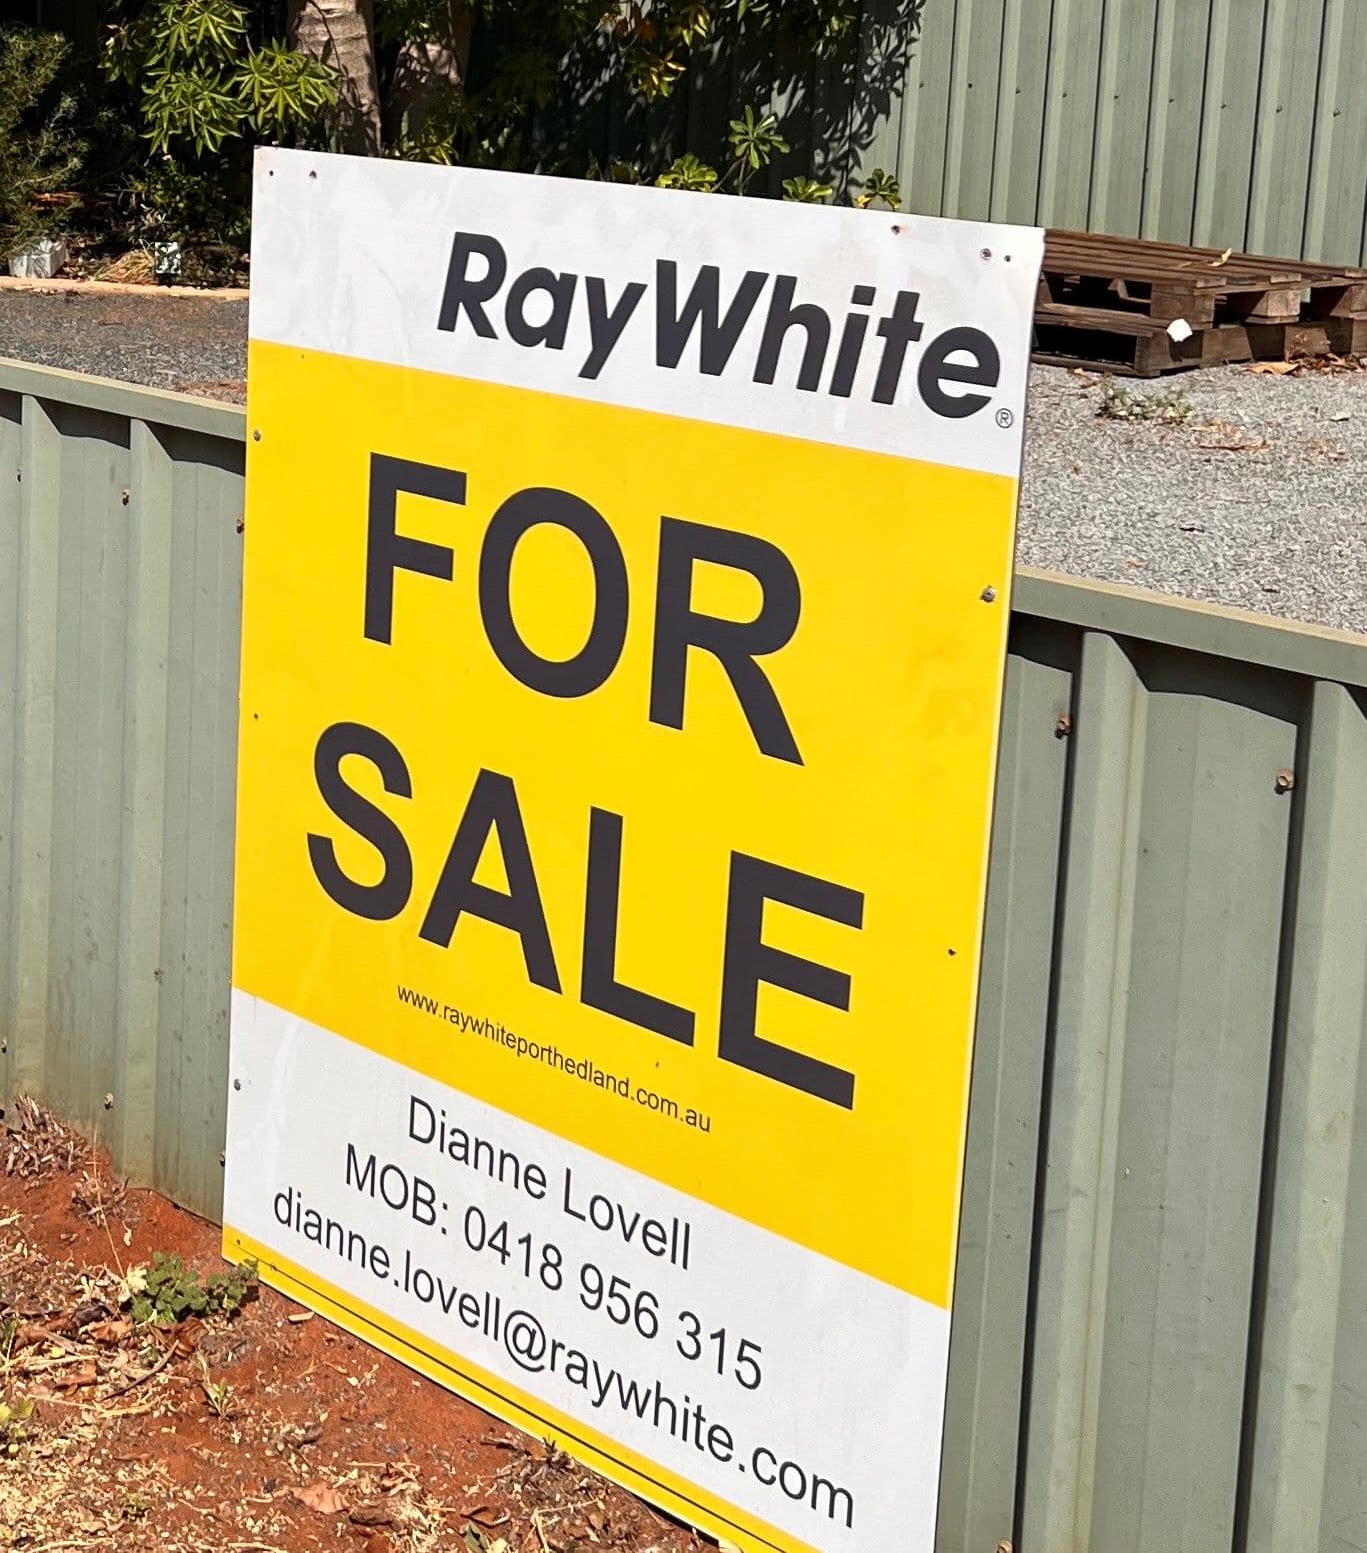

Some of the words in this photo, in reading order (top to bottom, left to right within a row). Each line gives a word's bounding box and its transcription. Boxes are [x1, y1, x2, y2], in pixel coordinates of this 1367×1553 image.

[363, 452, 805, 767] FOR
[306, 721, 866, 1111] SALE
[396, 984, 712, 1134] www.raywhiteporthedland.com.au
[408, 1094, 547, 1200] Dianne
[563, 1167, 691, 1270] Lovell
[273, 1185, 855, 1529] dianne.lovell@raywhite.com
[346, 1142, 450, 1235] MOB:
[464, 1205, 564, 1291] 0418
[579, 1263, 660, 1340] 956
[676, 1310, 763, 1391] 315
